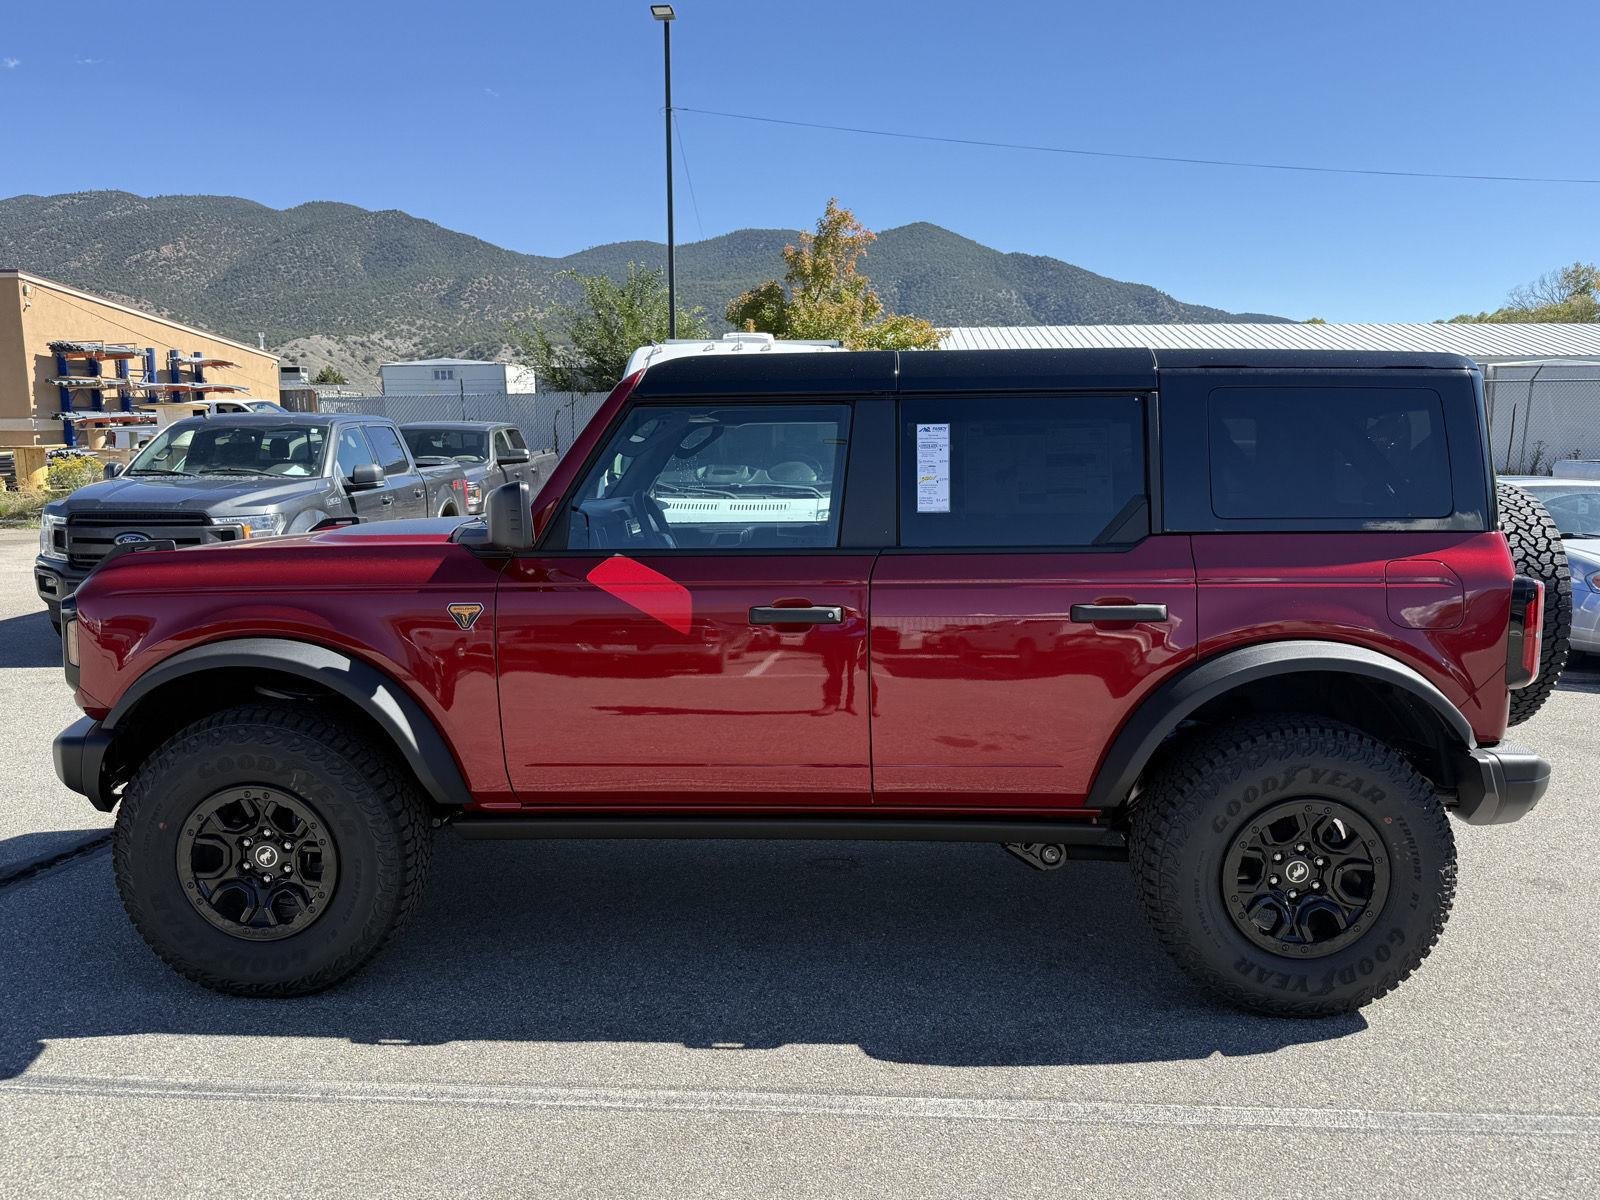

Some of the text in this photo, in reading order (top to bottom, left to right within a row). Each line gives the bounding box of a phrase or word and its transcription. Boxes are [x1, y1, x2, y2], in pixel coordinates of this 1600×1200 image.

[1211, 765, 1387, 834] GOODYEAR
[1396, 815, 1422, 884] TERRITORY
[1233, 927, 1406, 996] GOODYEAR
